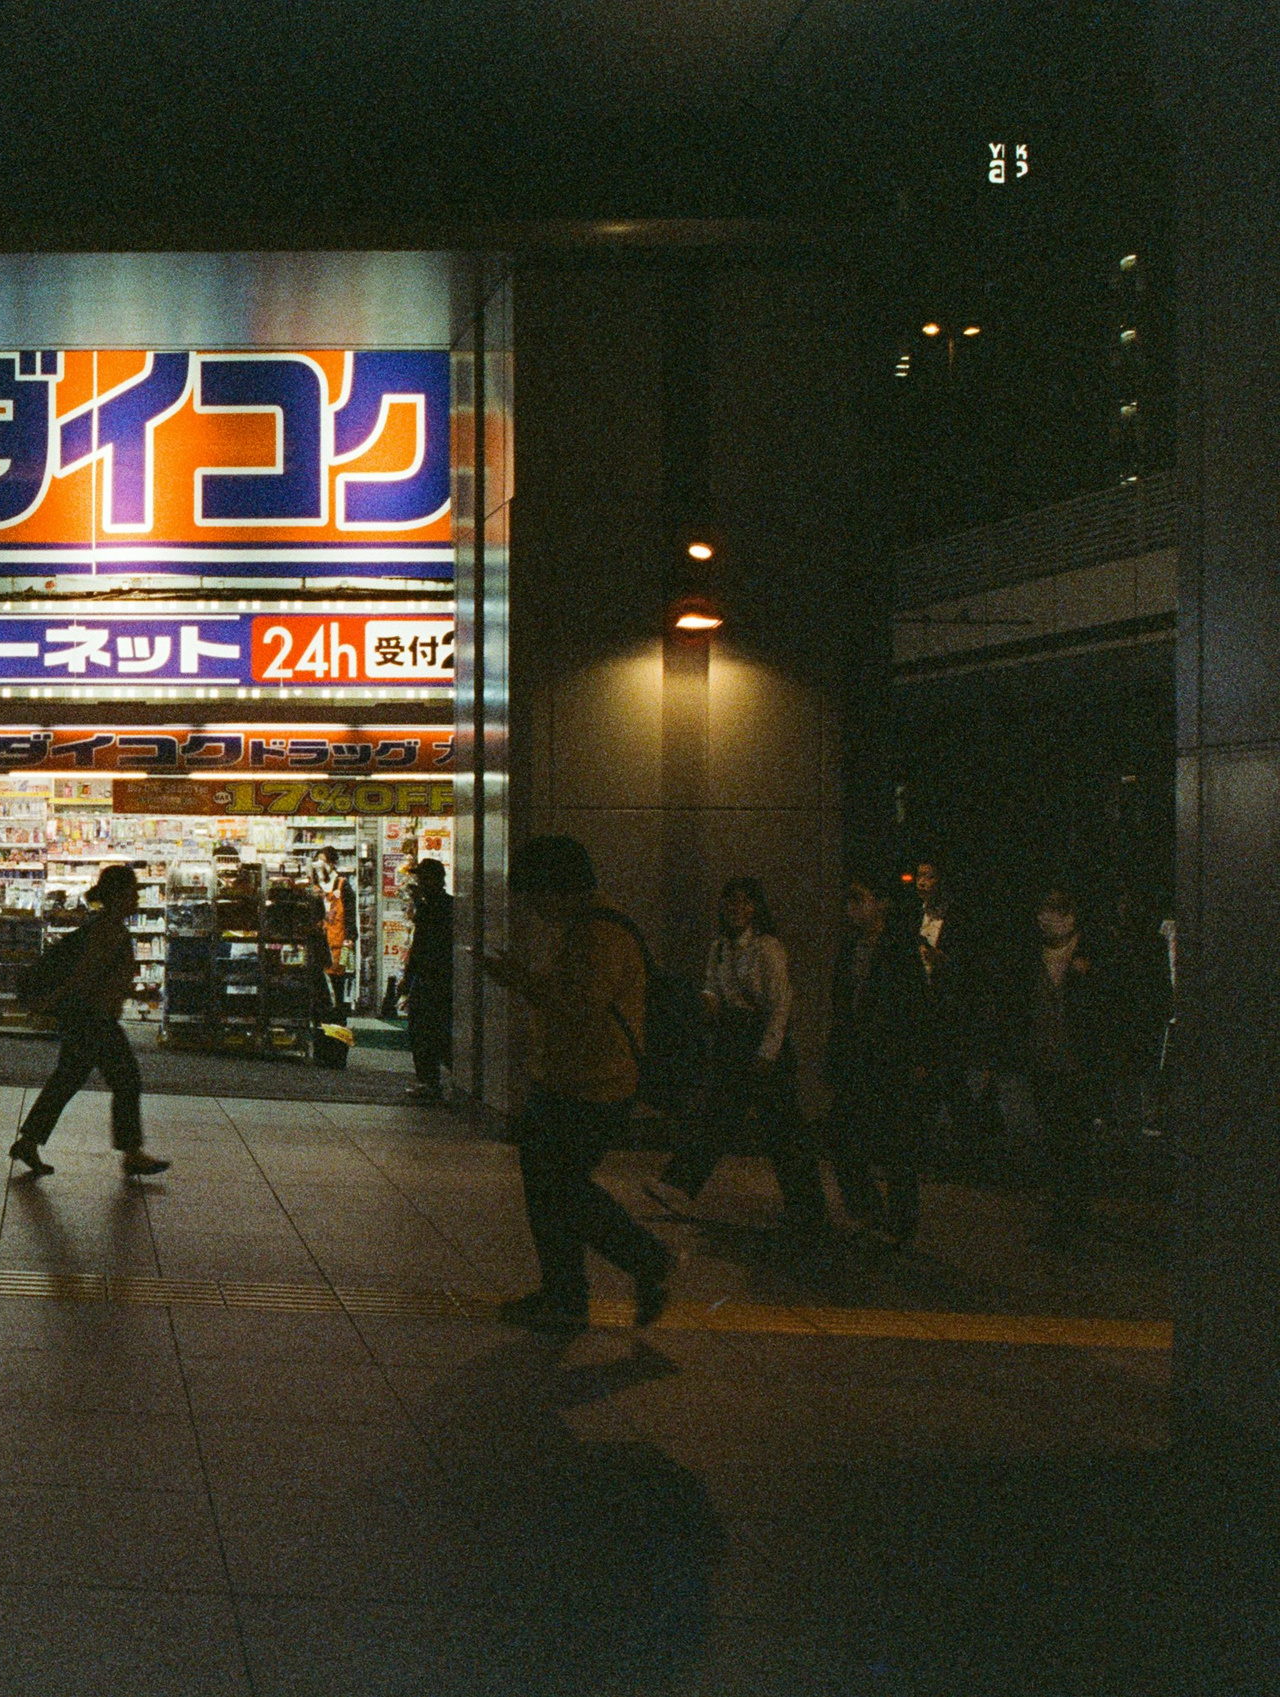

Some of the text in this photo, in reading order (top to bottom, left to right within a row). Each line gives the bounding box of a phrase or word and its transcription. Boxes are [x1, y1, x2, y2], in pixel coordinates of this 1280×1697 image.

[988, 142, 1028, 159] YK
[262, 621, 358, 679] 24h
[225, 782, 454, 814] 17%OFF
